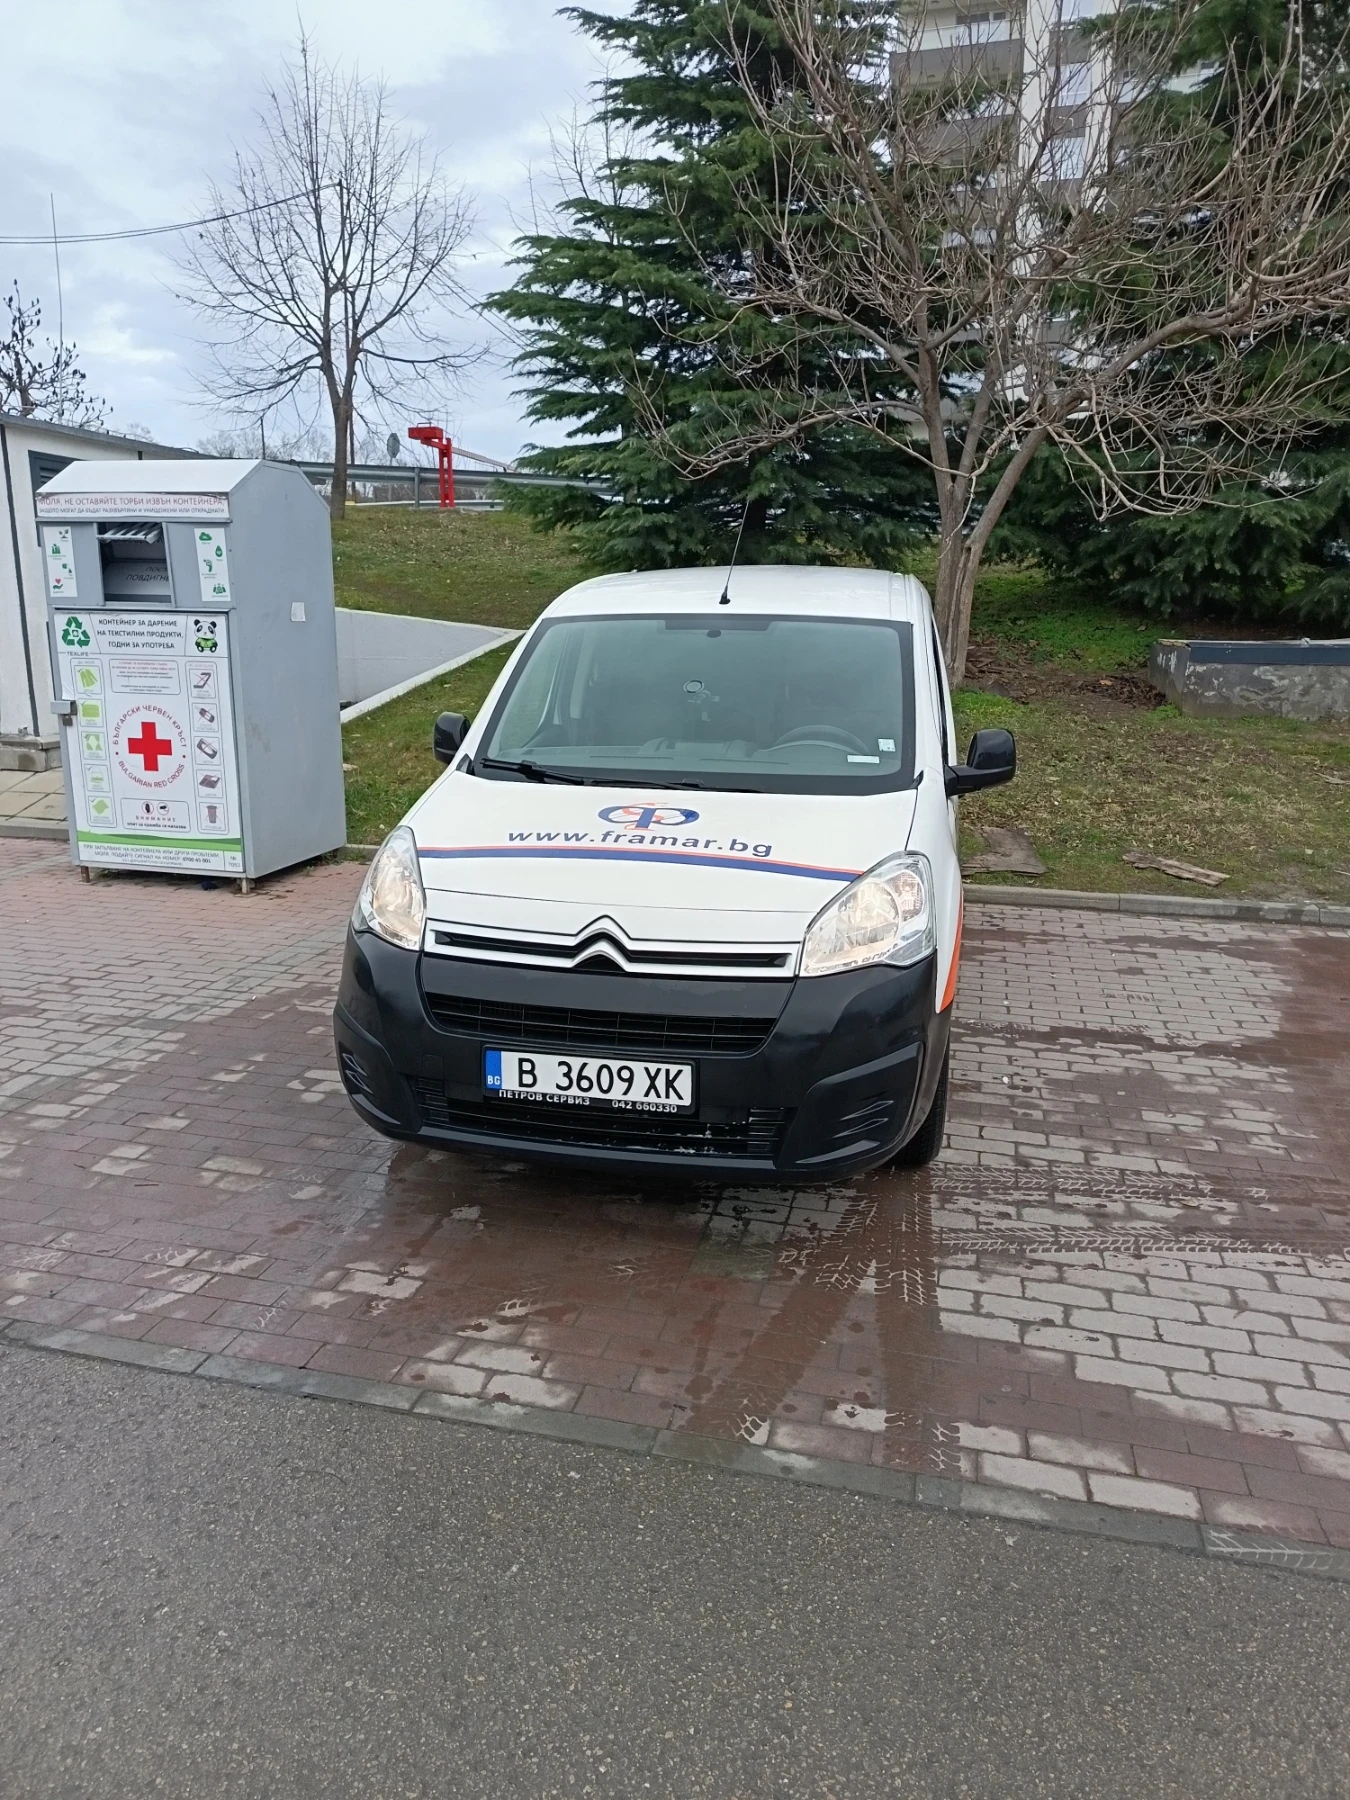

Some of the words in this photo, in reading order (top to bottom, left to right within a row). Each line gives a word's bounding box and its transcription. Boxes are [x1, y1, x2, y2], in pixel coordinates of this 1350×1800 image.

[75, 497, 117, 505] ОСТАВЯЙТЕ
[98, 618, 136, 626] КОНТЕЙНЕР
[147, 620, 178, 628] ДАРЕНИЕ
[146, 631, 184, 639] ПРОДУКТИ,
[113, 705, 141, 745] БЪЛГАРСКИ
[142, 705, 172, 721] ЧЕРВЕН
[172, 720, 187, 747] КРЪСТ
[118, 761, 152, 787] BULGARIAN
[154, 780, 167, 788] RED
[168, 764, 185, 783] CROSS
[508, 830, 773, 858] www.framar.bg
[487, 1075, 501, 1086] BG
[555, 1060, 635, 1096] 3609
[498, 1089, 543, 1101] ПЕТРОВ
[546, 1094, 590, 1106] СЕРВИЗ
[612, 1100, 632, 1109] 042
[635, 1101, 678, 1113] 660330
